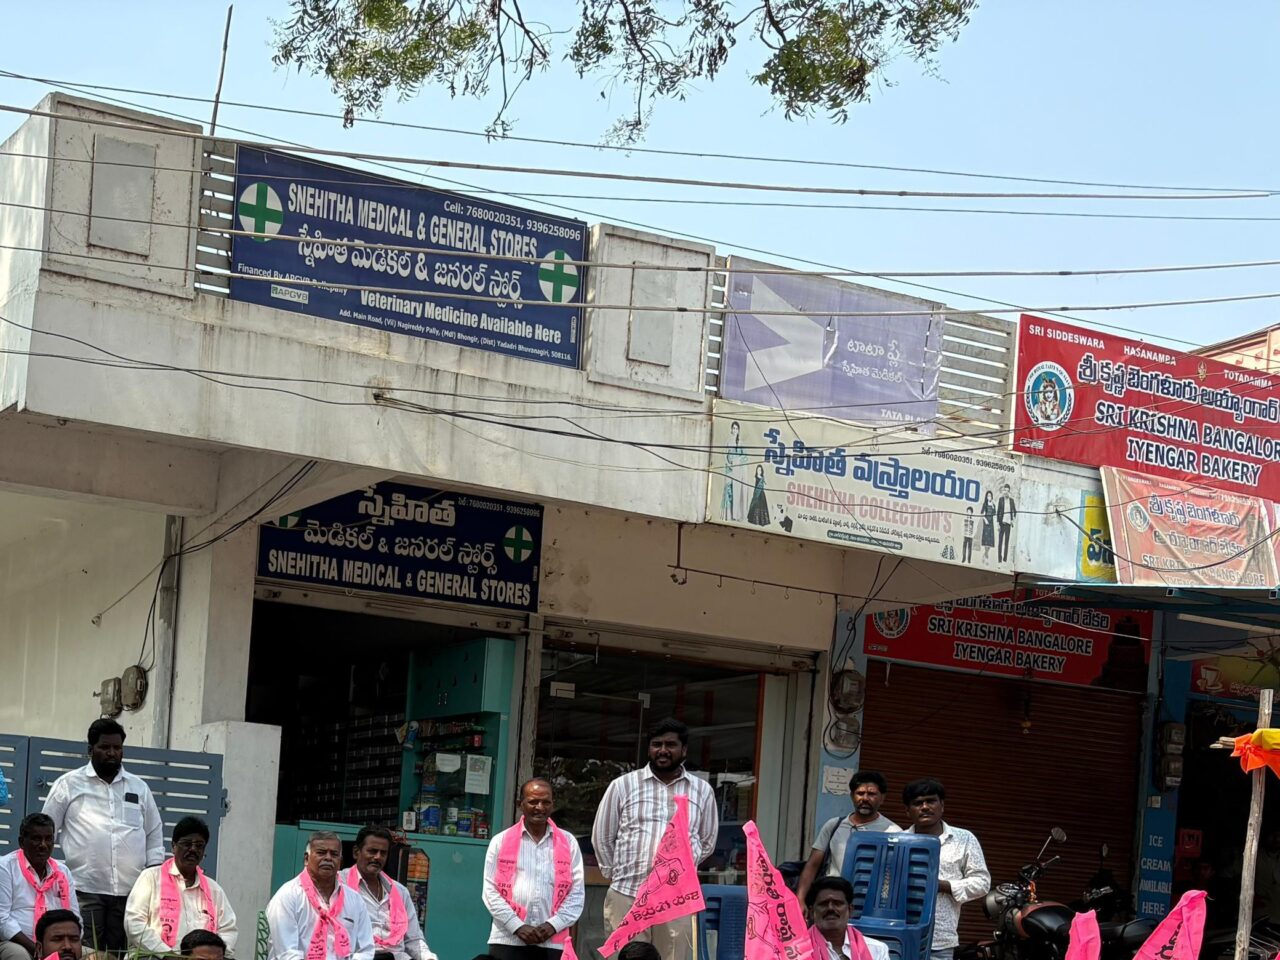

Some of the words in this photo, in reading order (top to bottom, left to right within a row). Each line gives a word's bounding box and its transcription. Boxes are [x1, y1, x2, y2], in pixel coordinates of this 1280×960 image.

[288, 183, 354, 225] SNEHITHA
[358, 198, 413, 238] MEDICAL
[417, 212, 426, 240] &
[430, 215, 486, 254] GENERAL
[490, 229, 538, 264] STORES
[444, 201, 464, 214] Cell:
[466, 206, 524, 230] 7680020351,
[526, 220, 581, 240] 9396258096
[238, 263, 271, 278] Financed
[415, 252, 430, 281] &
[353, 312, 366, 321] Main
[361, 290, 422, 318] Veterinary
[424, 301, 478, 328] Medicine
[480, 312, 532, 338] Available
[535, 324, 562, 344] Here
[1029, 324, 1044, 336] SRI
[1046, 329, 1105, 350] SIDDESWARA
[1124, 346, 1176, 366] HASANAMBA
[880, 408, 902, 420] TATA
[1094, 400, 1124, 428] SRI
[1128, 406, 1200, 444] KRISHNA
[764, 428, 847, 478] స్నేహిత
[1127, 438, 1197, 472] IYENGAR
[1200, 452, 1262, 486] BAKERY
[786, 482, 856, 515] SNEHITHA
[858, 495, 952, 534] COLLECTION'S
[304, 519, 376, 551] మెడికల్
[378, 538, 390, 554] &
[394, 536, 456, 562] జనరల్
[268, 550, 338, 581] SNEHITHA
[342, 559, 402, 590] MEDICAL
[406, 572, 413, 588] &
[416, 569, 478, 600] GENERAL
[480, 579, 531, 606] STORES
[927, 616, 953, 634] SRI
[955, 620, 1015, 644] KRISHNA
[1018, 630, 1093, 656] BANGALORE
[953, 642, 1012, 666] IYENGAR
[1014, 652, 1067, 674] BAKERY
[1149, 834, 1164, 847] ICE
[1141, 858, 1172, 872] CREAM
[1142, 901, 1166, 916] HERE
